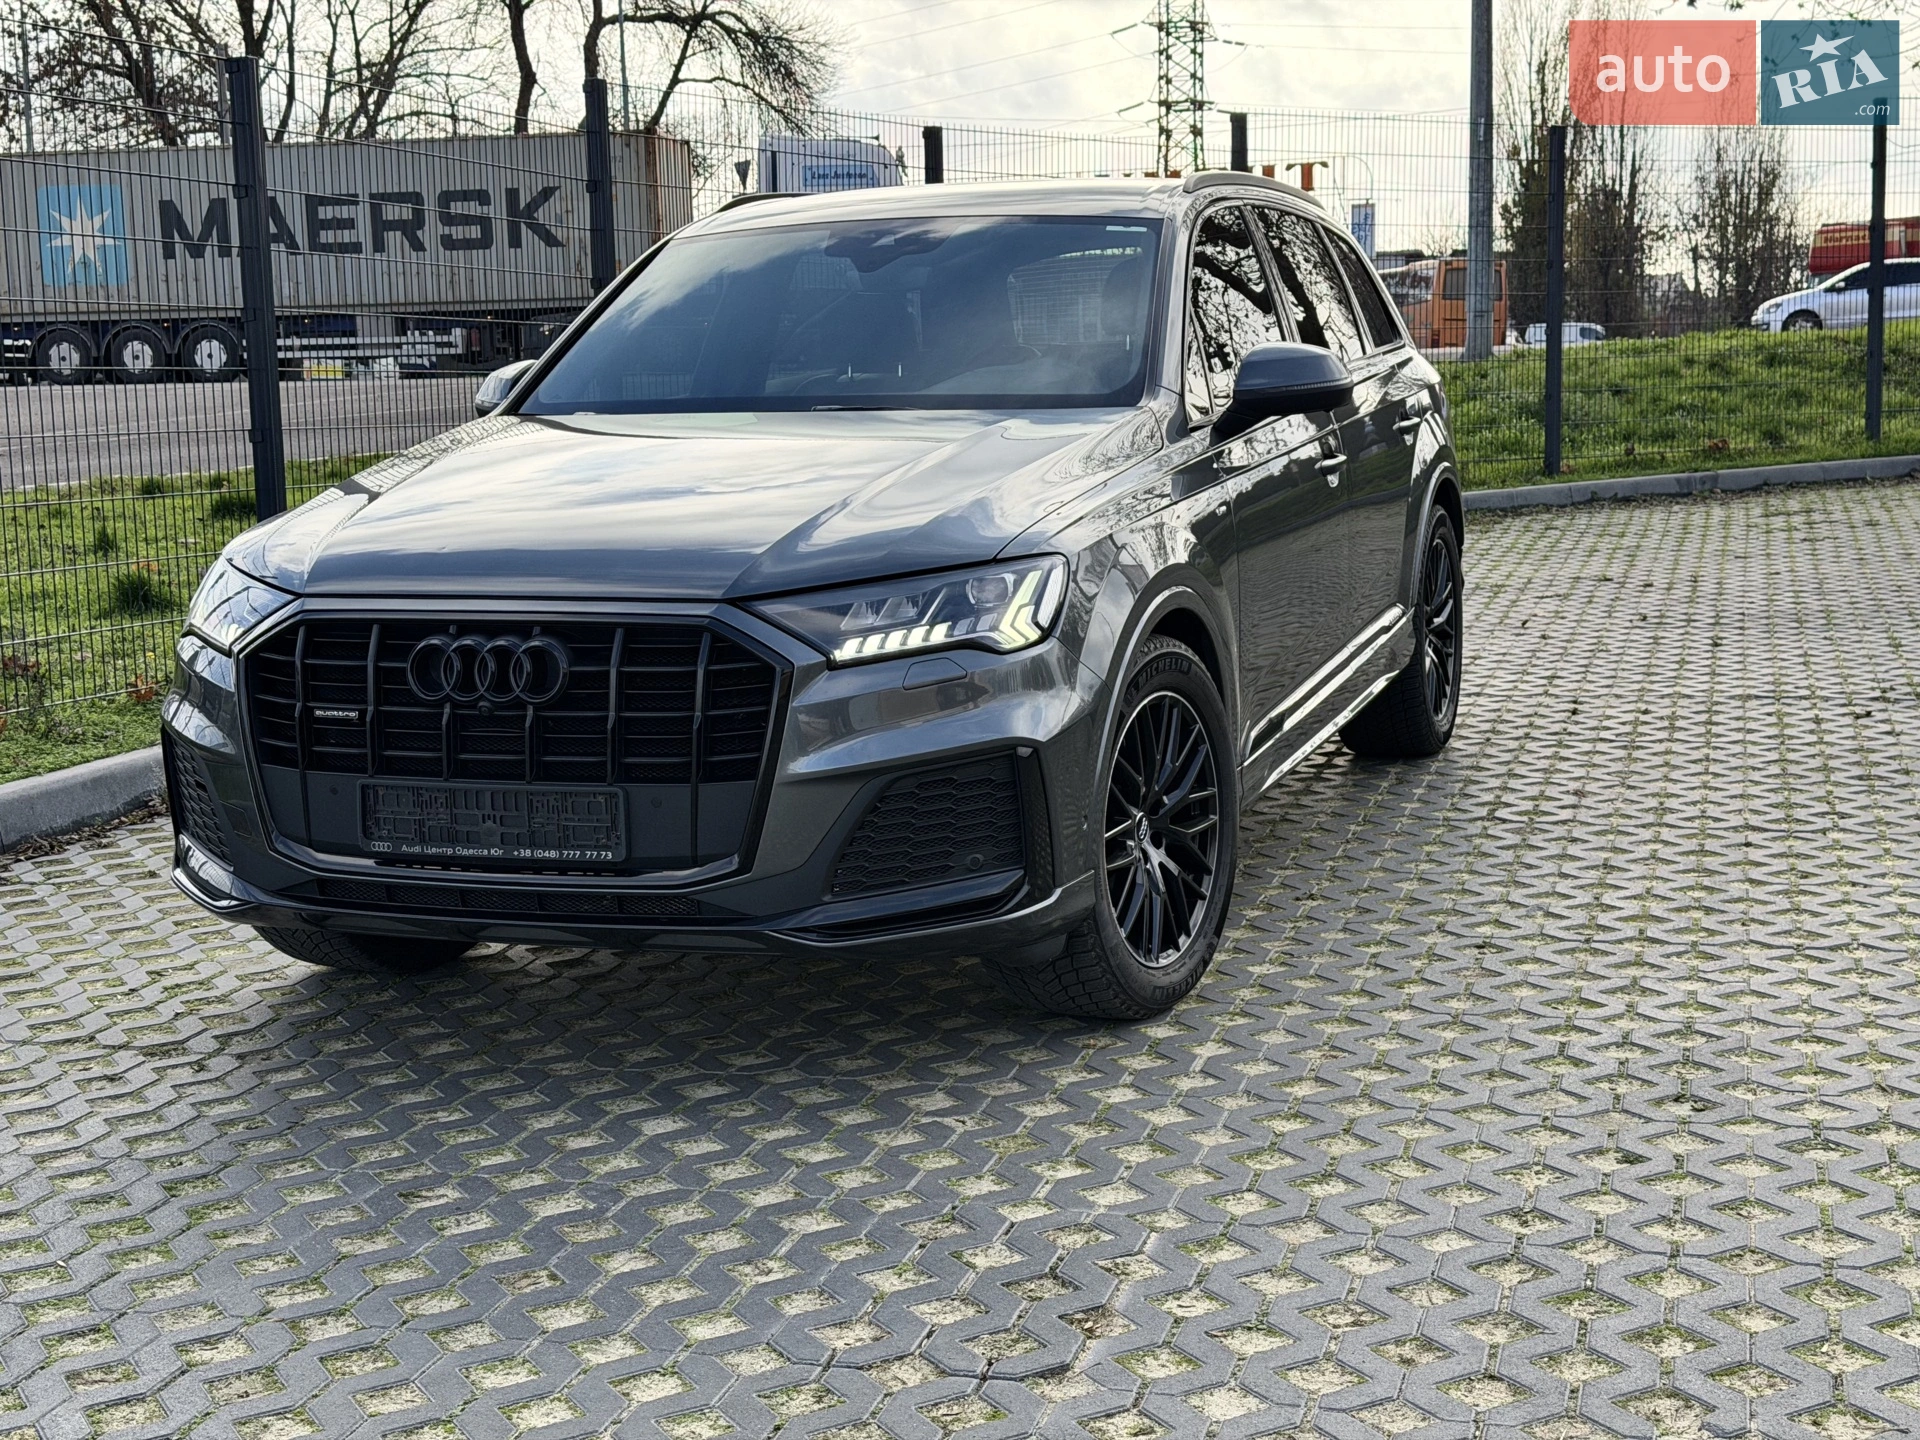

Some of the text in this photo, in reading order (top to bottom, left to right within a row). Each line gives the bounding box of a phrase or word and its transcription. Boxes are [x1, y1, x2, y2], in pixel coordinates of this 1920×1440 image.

[159, 185, 566, 261] MAERSK
[1138, 658, 1190, 689] MICHELIN
[315, 710, 357, 718] quattro
[401, 844, 422, 853] Audi
[424, 845, 454, 855] Центр
[455, 846, 488, 856] Одесса
[490, 847, 504, 857] Юг
[513, 849, 532, 857] +38
[533, 849, 560, 858] (048)
[562, 850, 581, 859] 777
